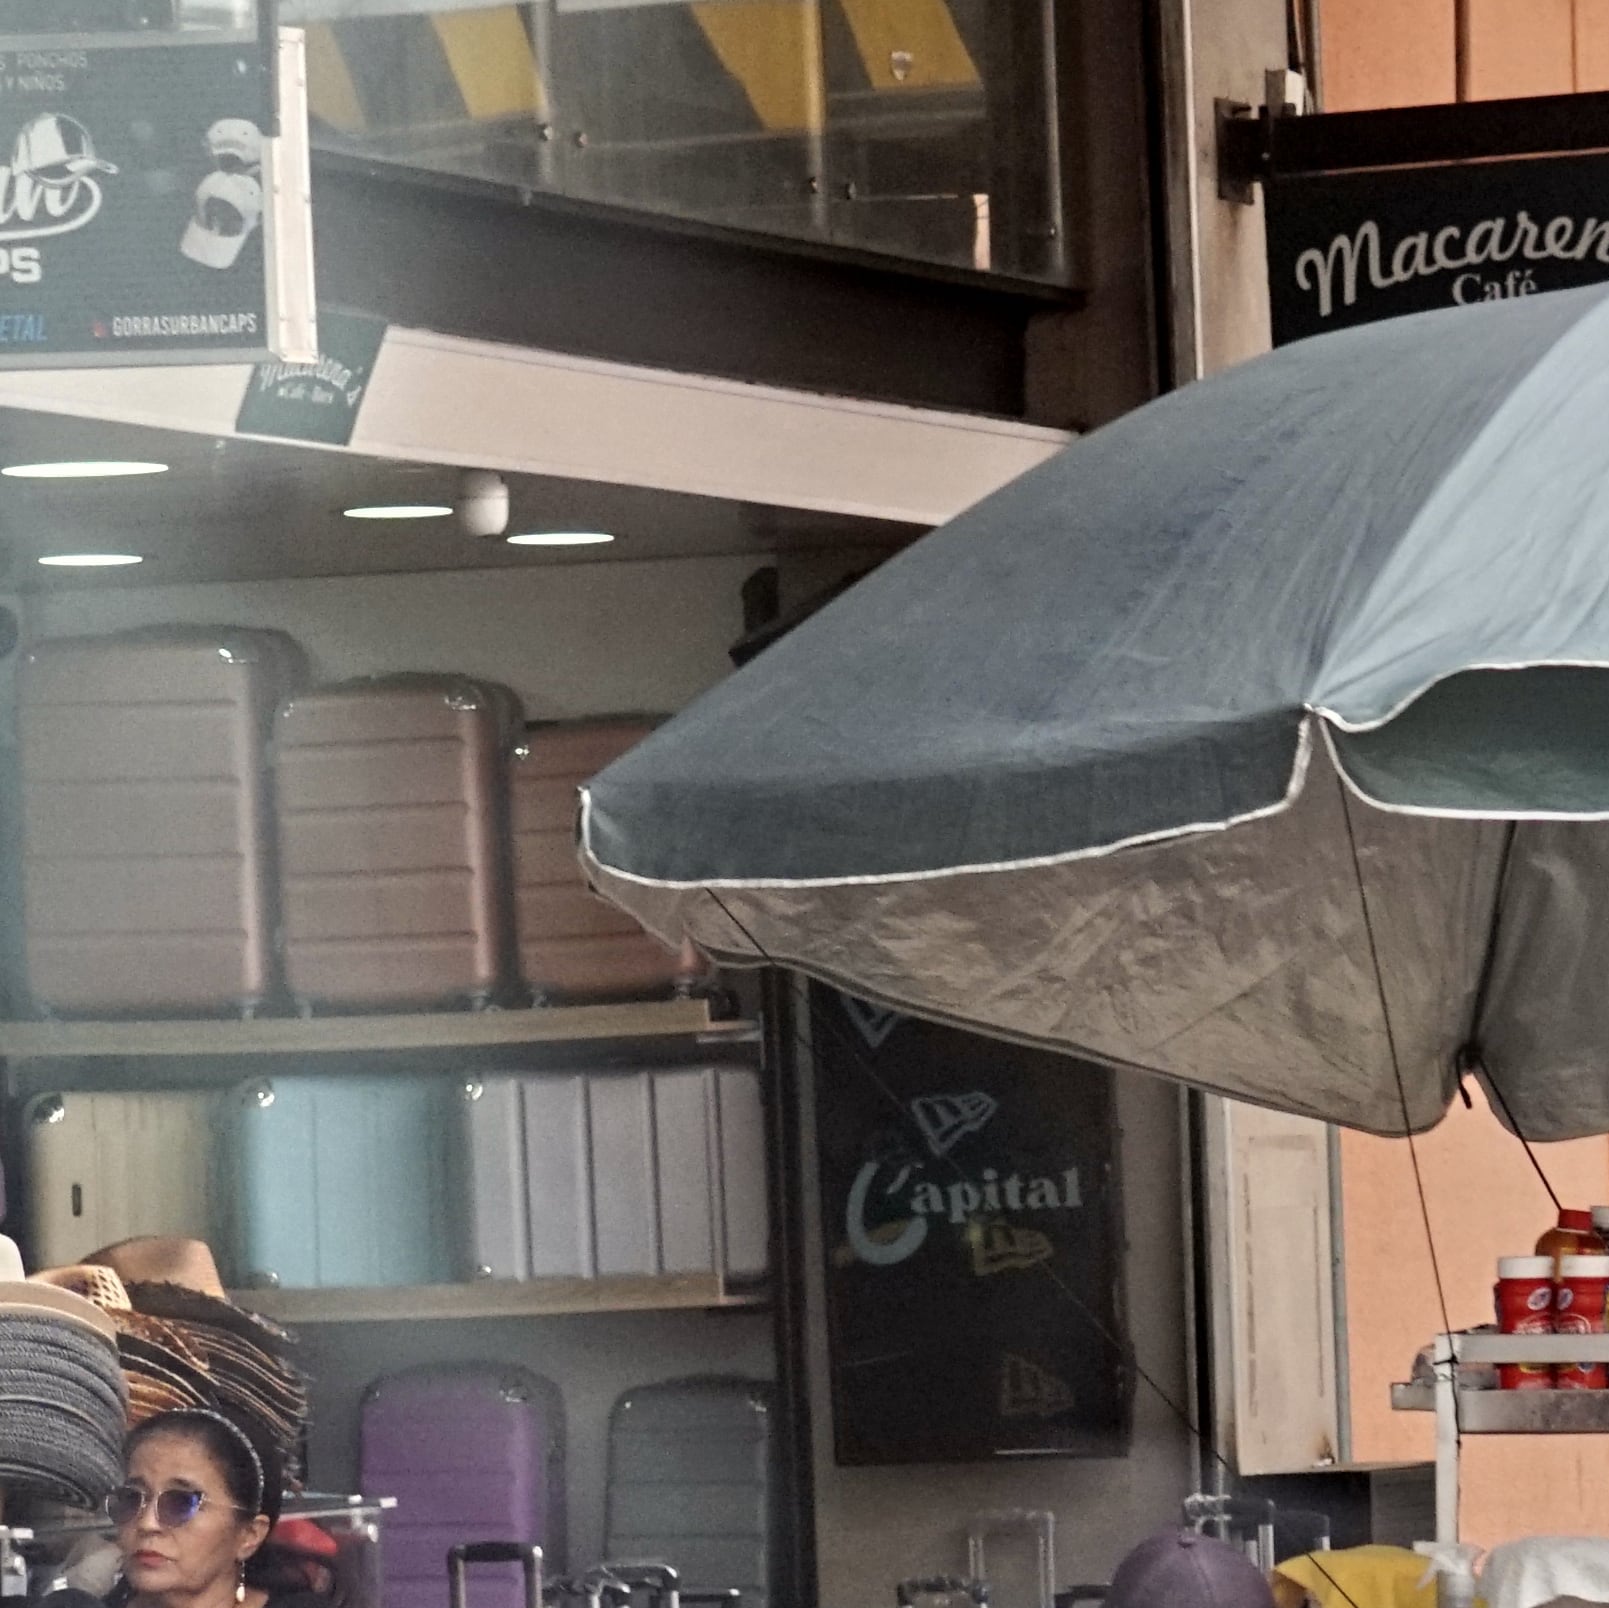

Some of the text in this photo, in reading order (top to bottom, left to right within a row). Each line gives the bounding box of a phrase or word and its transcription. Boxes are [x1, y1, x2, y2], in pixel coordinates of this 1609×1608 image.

[1452, 267, 1537, 306] Café
[113, 313, 257, 337] GORRASURBANCAPS
[846, 1161, 1083, 1266] Capital
